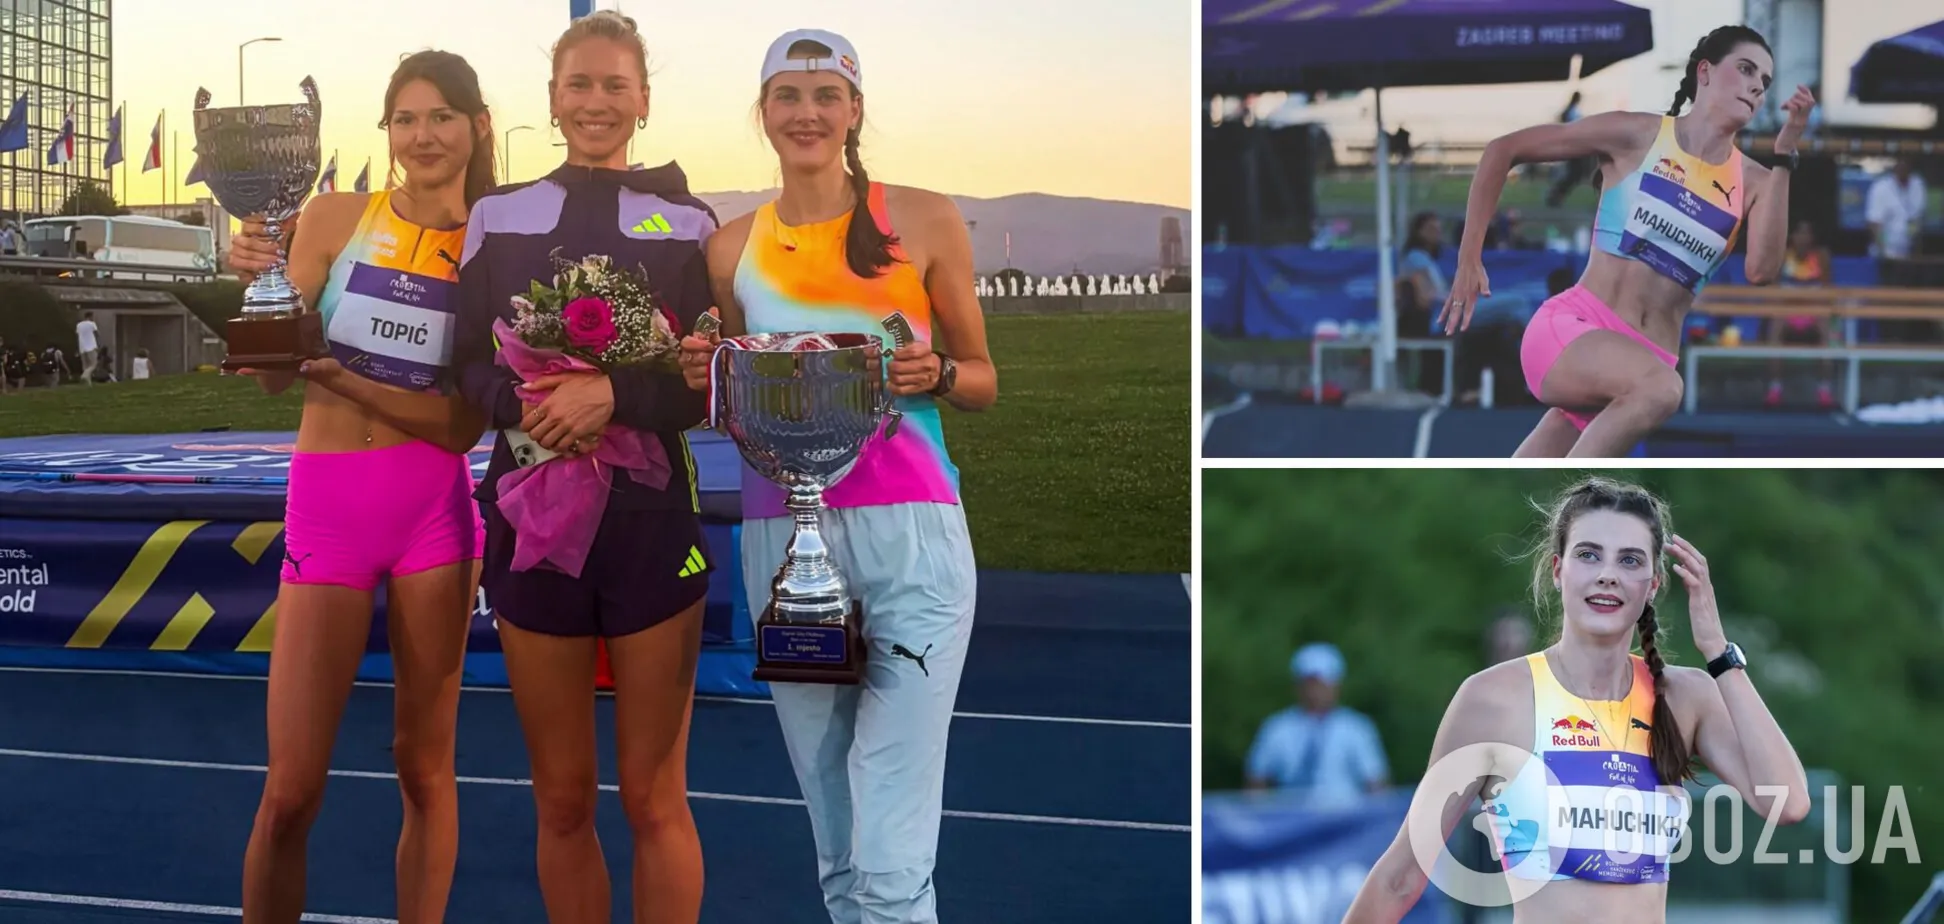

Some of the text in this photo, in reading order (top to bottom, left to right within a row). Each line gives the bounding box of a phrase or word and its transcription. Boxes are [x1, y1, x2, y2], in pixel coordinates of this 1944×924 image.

[1456, 22, 1625, 46] ZAGREB MEETING
[1652, 165, 1686, 185] Red Bull
[1633, 206, 1717, 263] MAHUCHIKH
[371, 316, 428, 346] TOPIĆ
[0, 589, 37, 613] old
[1552, 735, 1600, 747] Red Bull
[1602, 760, 1639, 773] CROATIA
[1558, 806, 1682, 839] MAHUCHIKH
